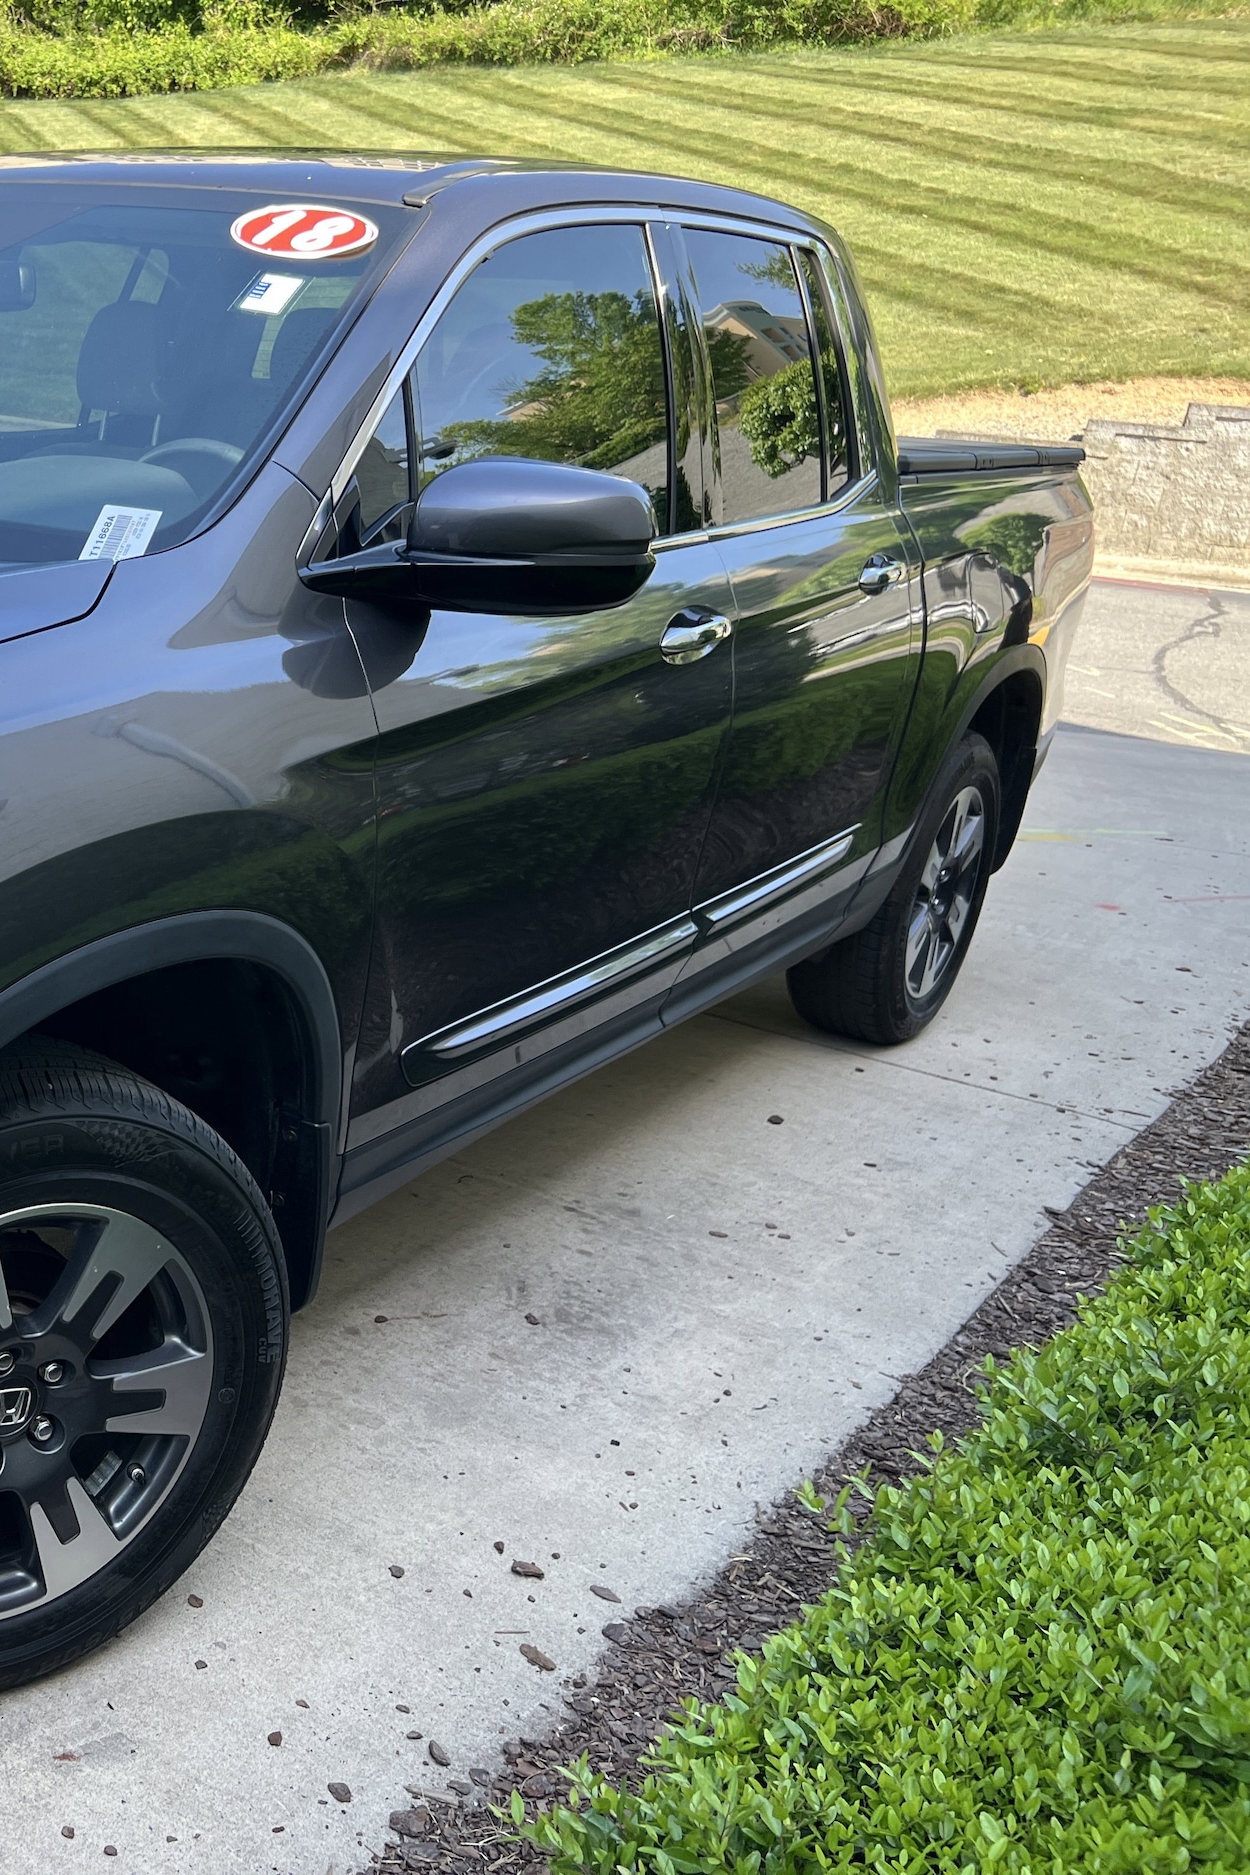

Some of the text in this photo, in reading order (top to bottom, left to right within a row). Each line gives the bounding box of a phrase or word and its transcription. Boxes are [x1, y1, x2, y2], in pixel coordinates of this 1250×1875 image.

[251, 210, 355, 251] 18
[89, 515, 116, 556] T11668A
[251, 1240, 281, 1364] MOHAVE
[257, 1336, 267, 1364] CUV
